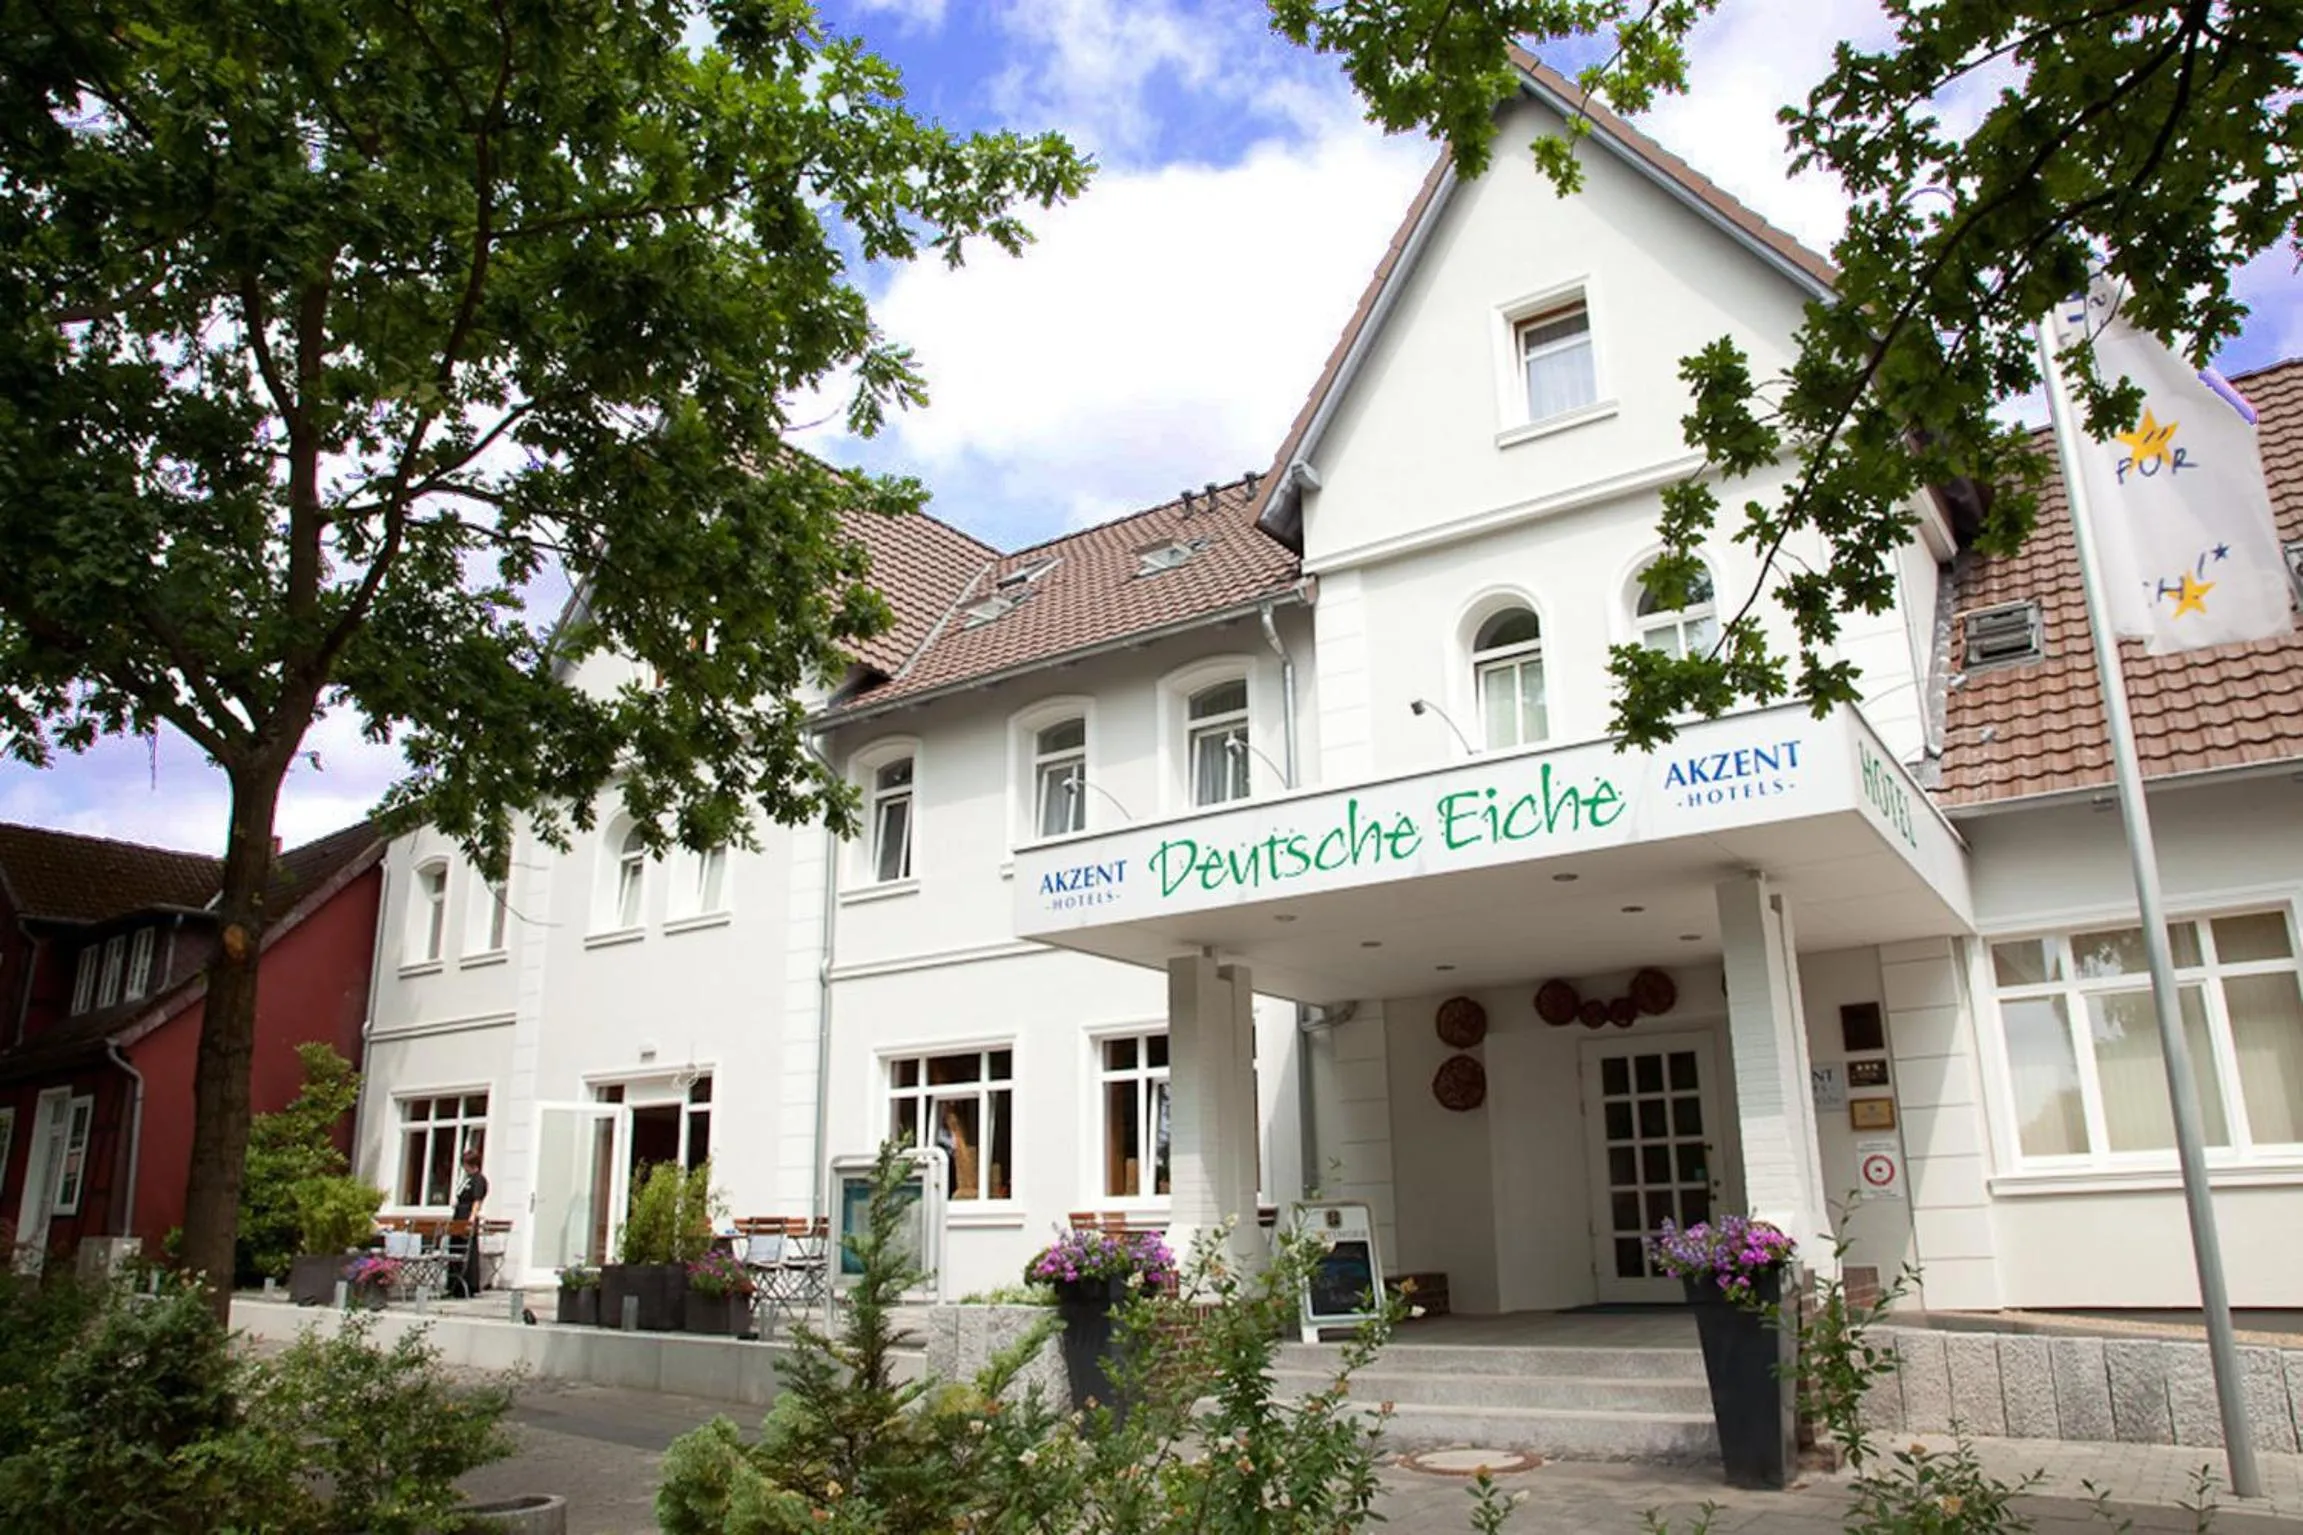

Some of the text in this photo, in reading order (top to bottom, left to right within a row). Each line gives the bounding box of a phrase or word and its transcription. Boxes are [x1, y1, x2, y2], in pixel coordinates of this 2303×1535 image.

[1664, 739, 1802, 790] AKZENT
[1858, 739, 1917, 849] HOTEL
[1149, 763, 1627, 898] Deutsche Eiche
[1039, 859, 1127, 896] AKZENT
